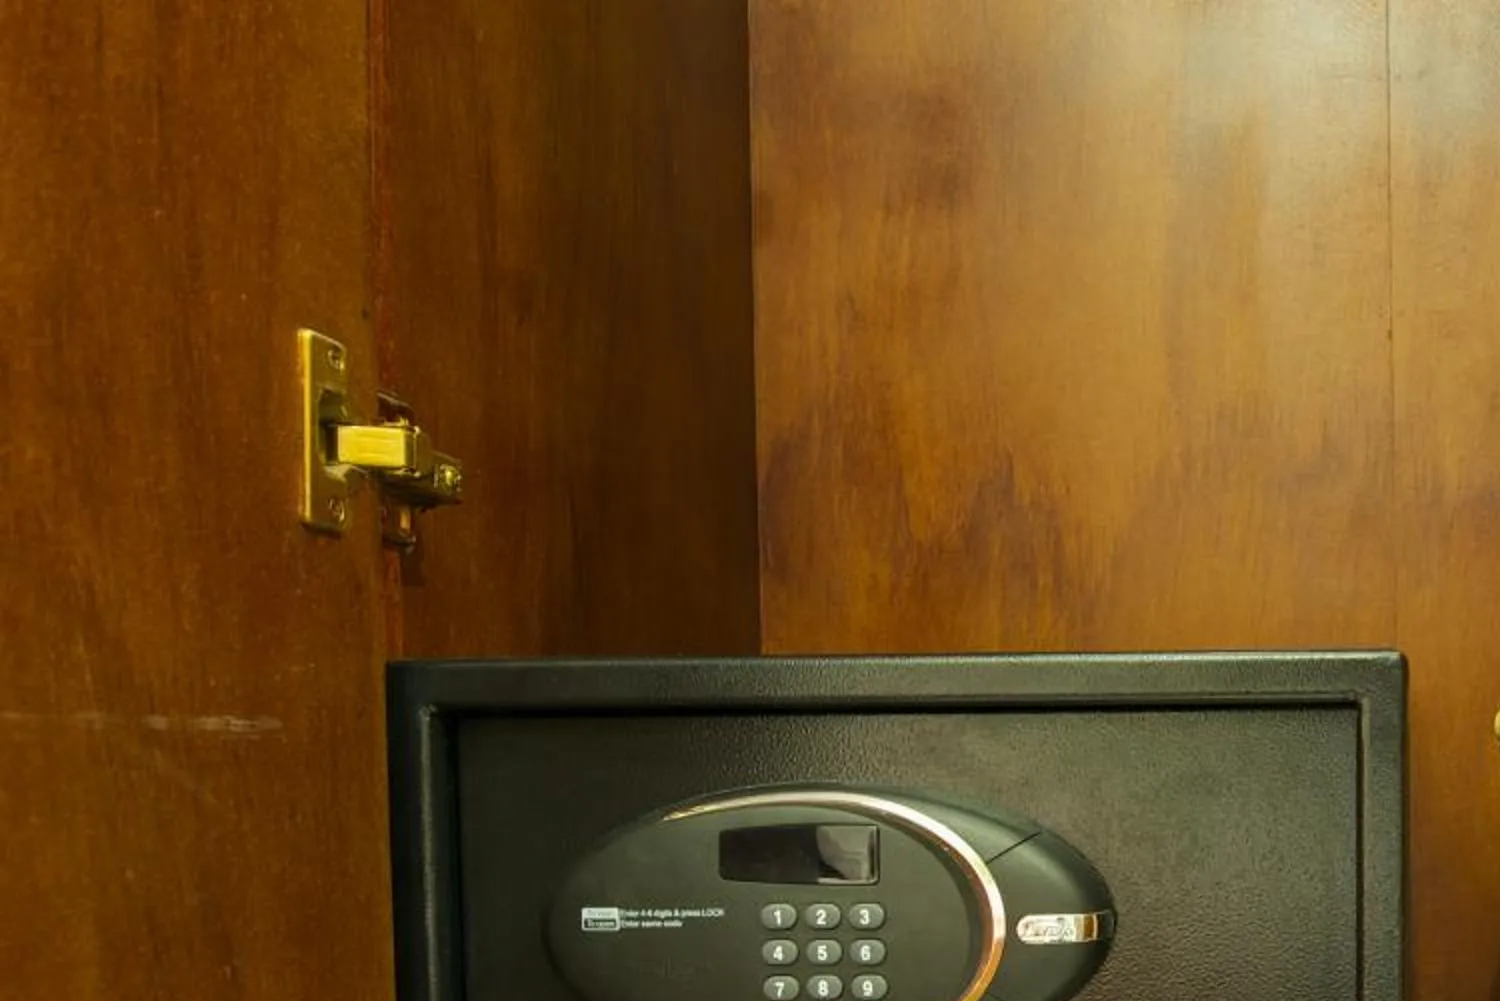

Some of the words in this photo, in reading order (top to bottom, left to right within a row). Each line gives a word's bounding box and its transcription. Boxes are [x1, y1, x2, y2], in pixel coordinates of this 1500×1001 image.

[773, 909, 782, 926] 1
[815, 909, 827, 925] 2
[859, 908, 870, 925] 3
[773, 945, 783, 961] 4
[817, 945, 828, 961] 5
[860, 945, 871, 961] 6
[775, 981, 785, 998] 7
[817, 980, 829, 996] 8
[861, 980, 873, 996] 9
